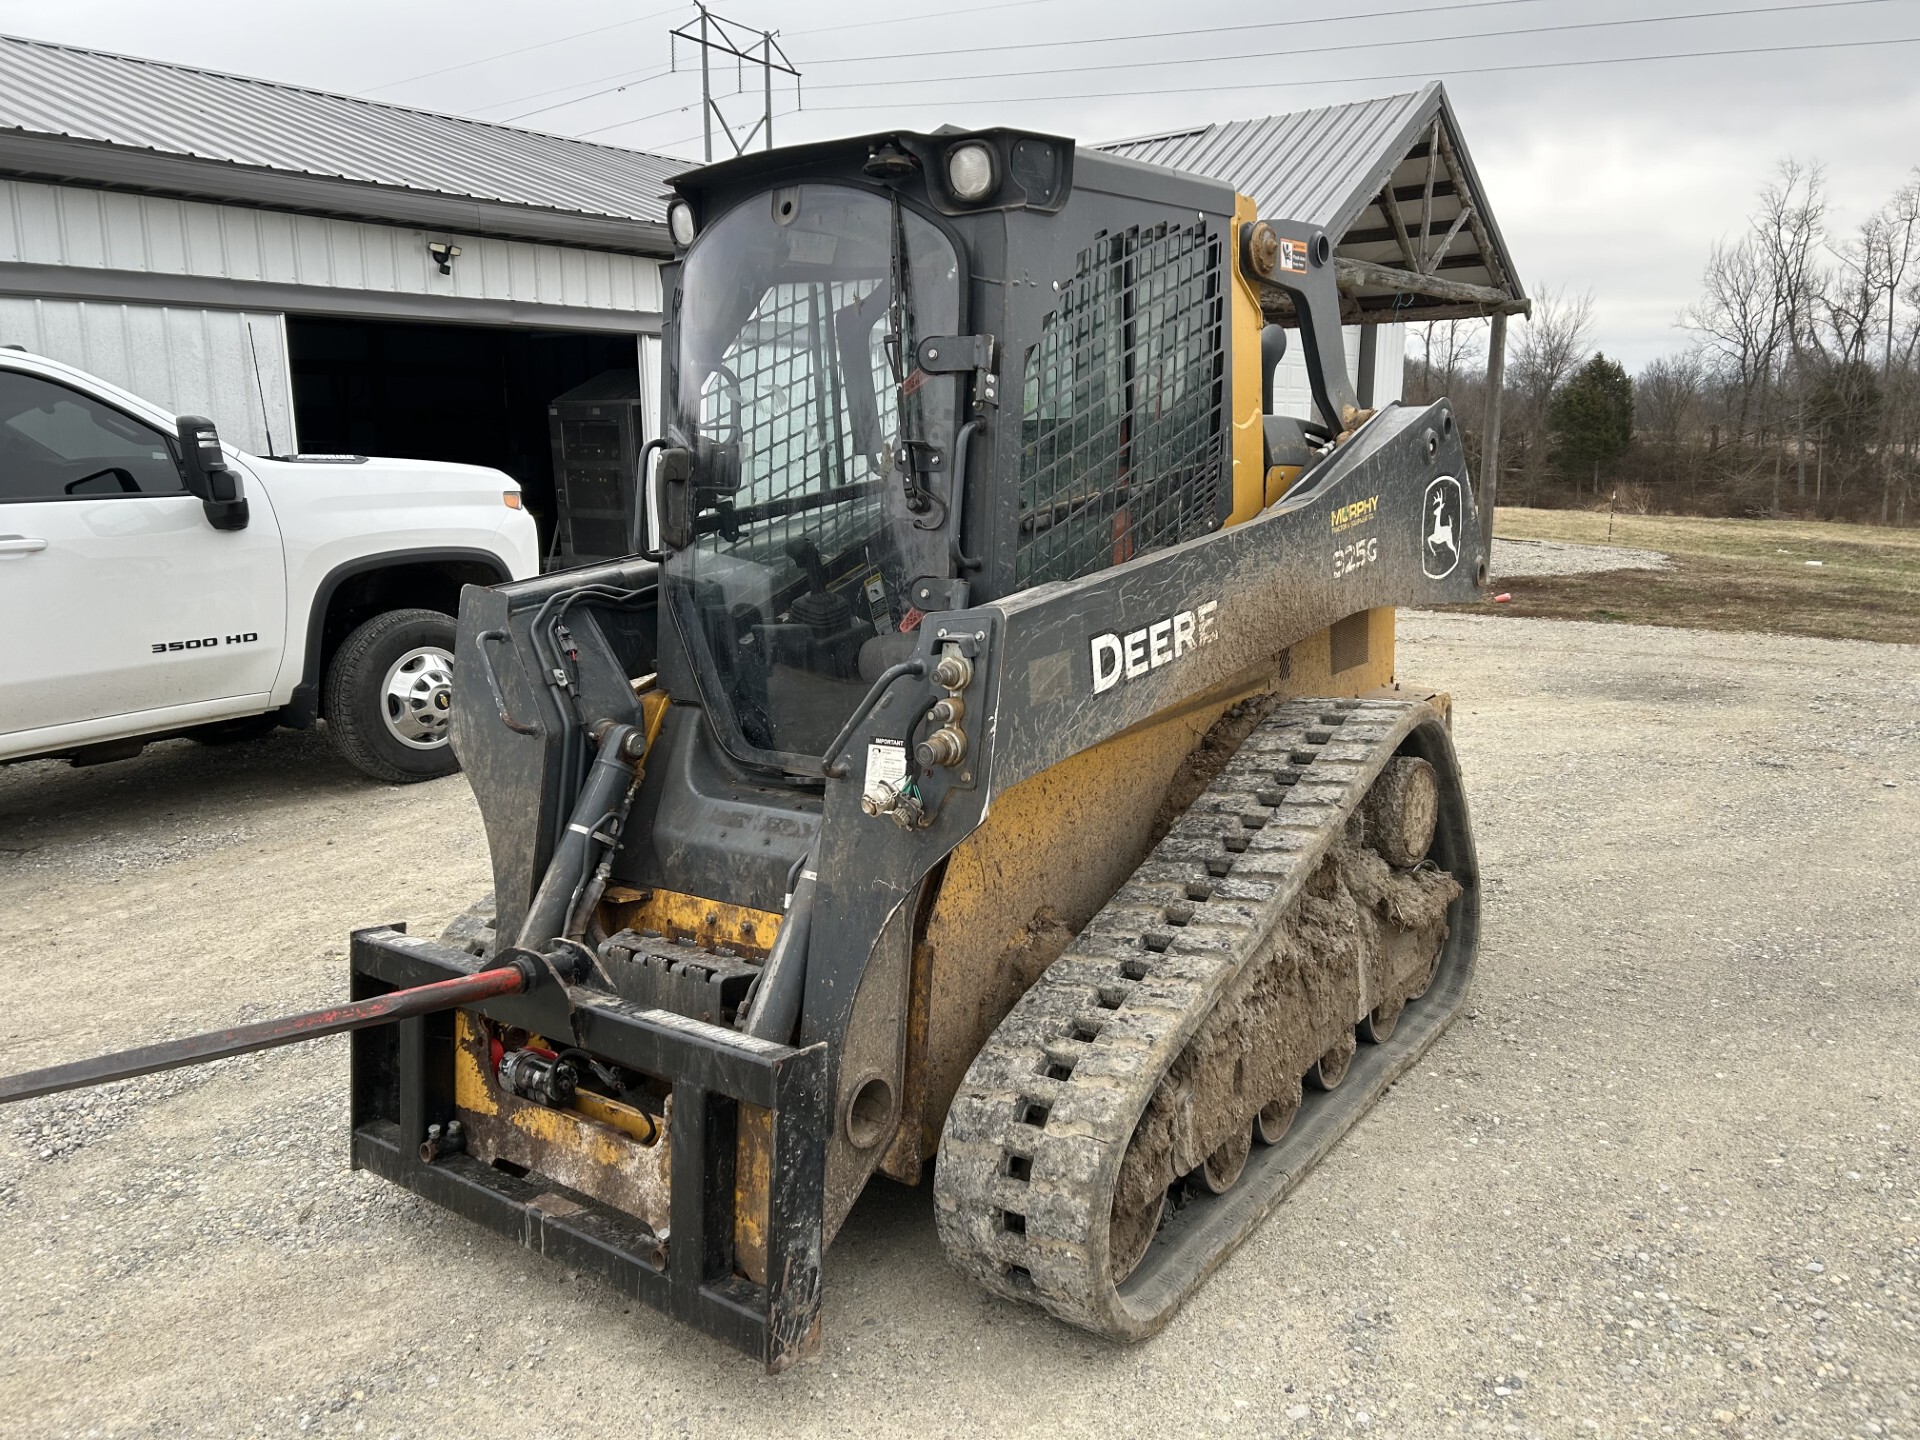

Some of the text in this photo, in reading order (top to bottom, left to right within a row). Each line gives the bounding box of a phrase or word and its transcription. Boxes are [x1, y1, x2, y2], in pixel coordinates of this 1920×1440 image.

[1331, 494, 1379, 527] MURPHY
[151, 632, 258, 653] 3500 HD
[1091, 600, 1218, 695] DEERE
[875, 737, 905, 746] IMPORTANT
